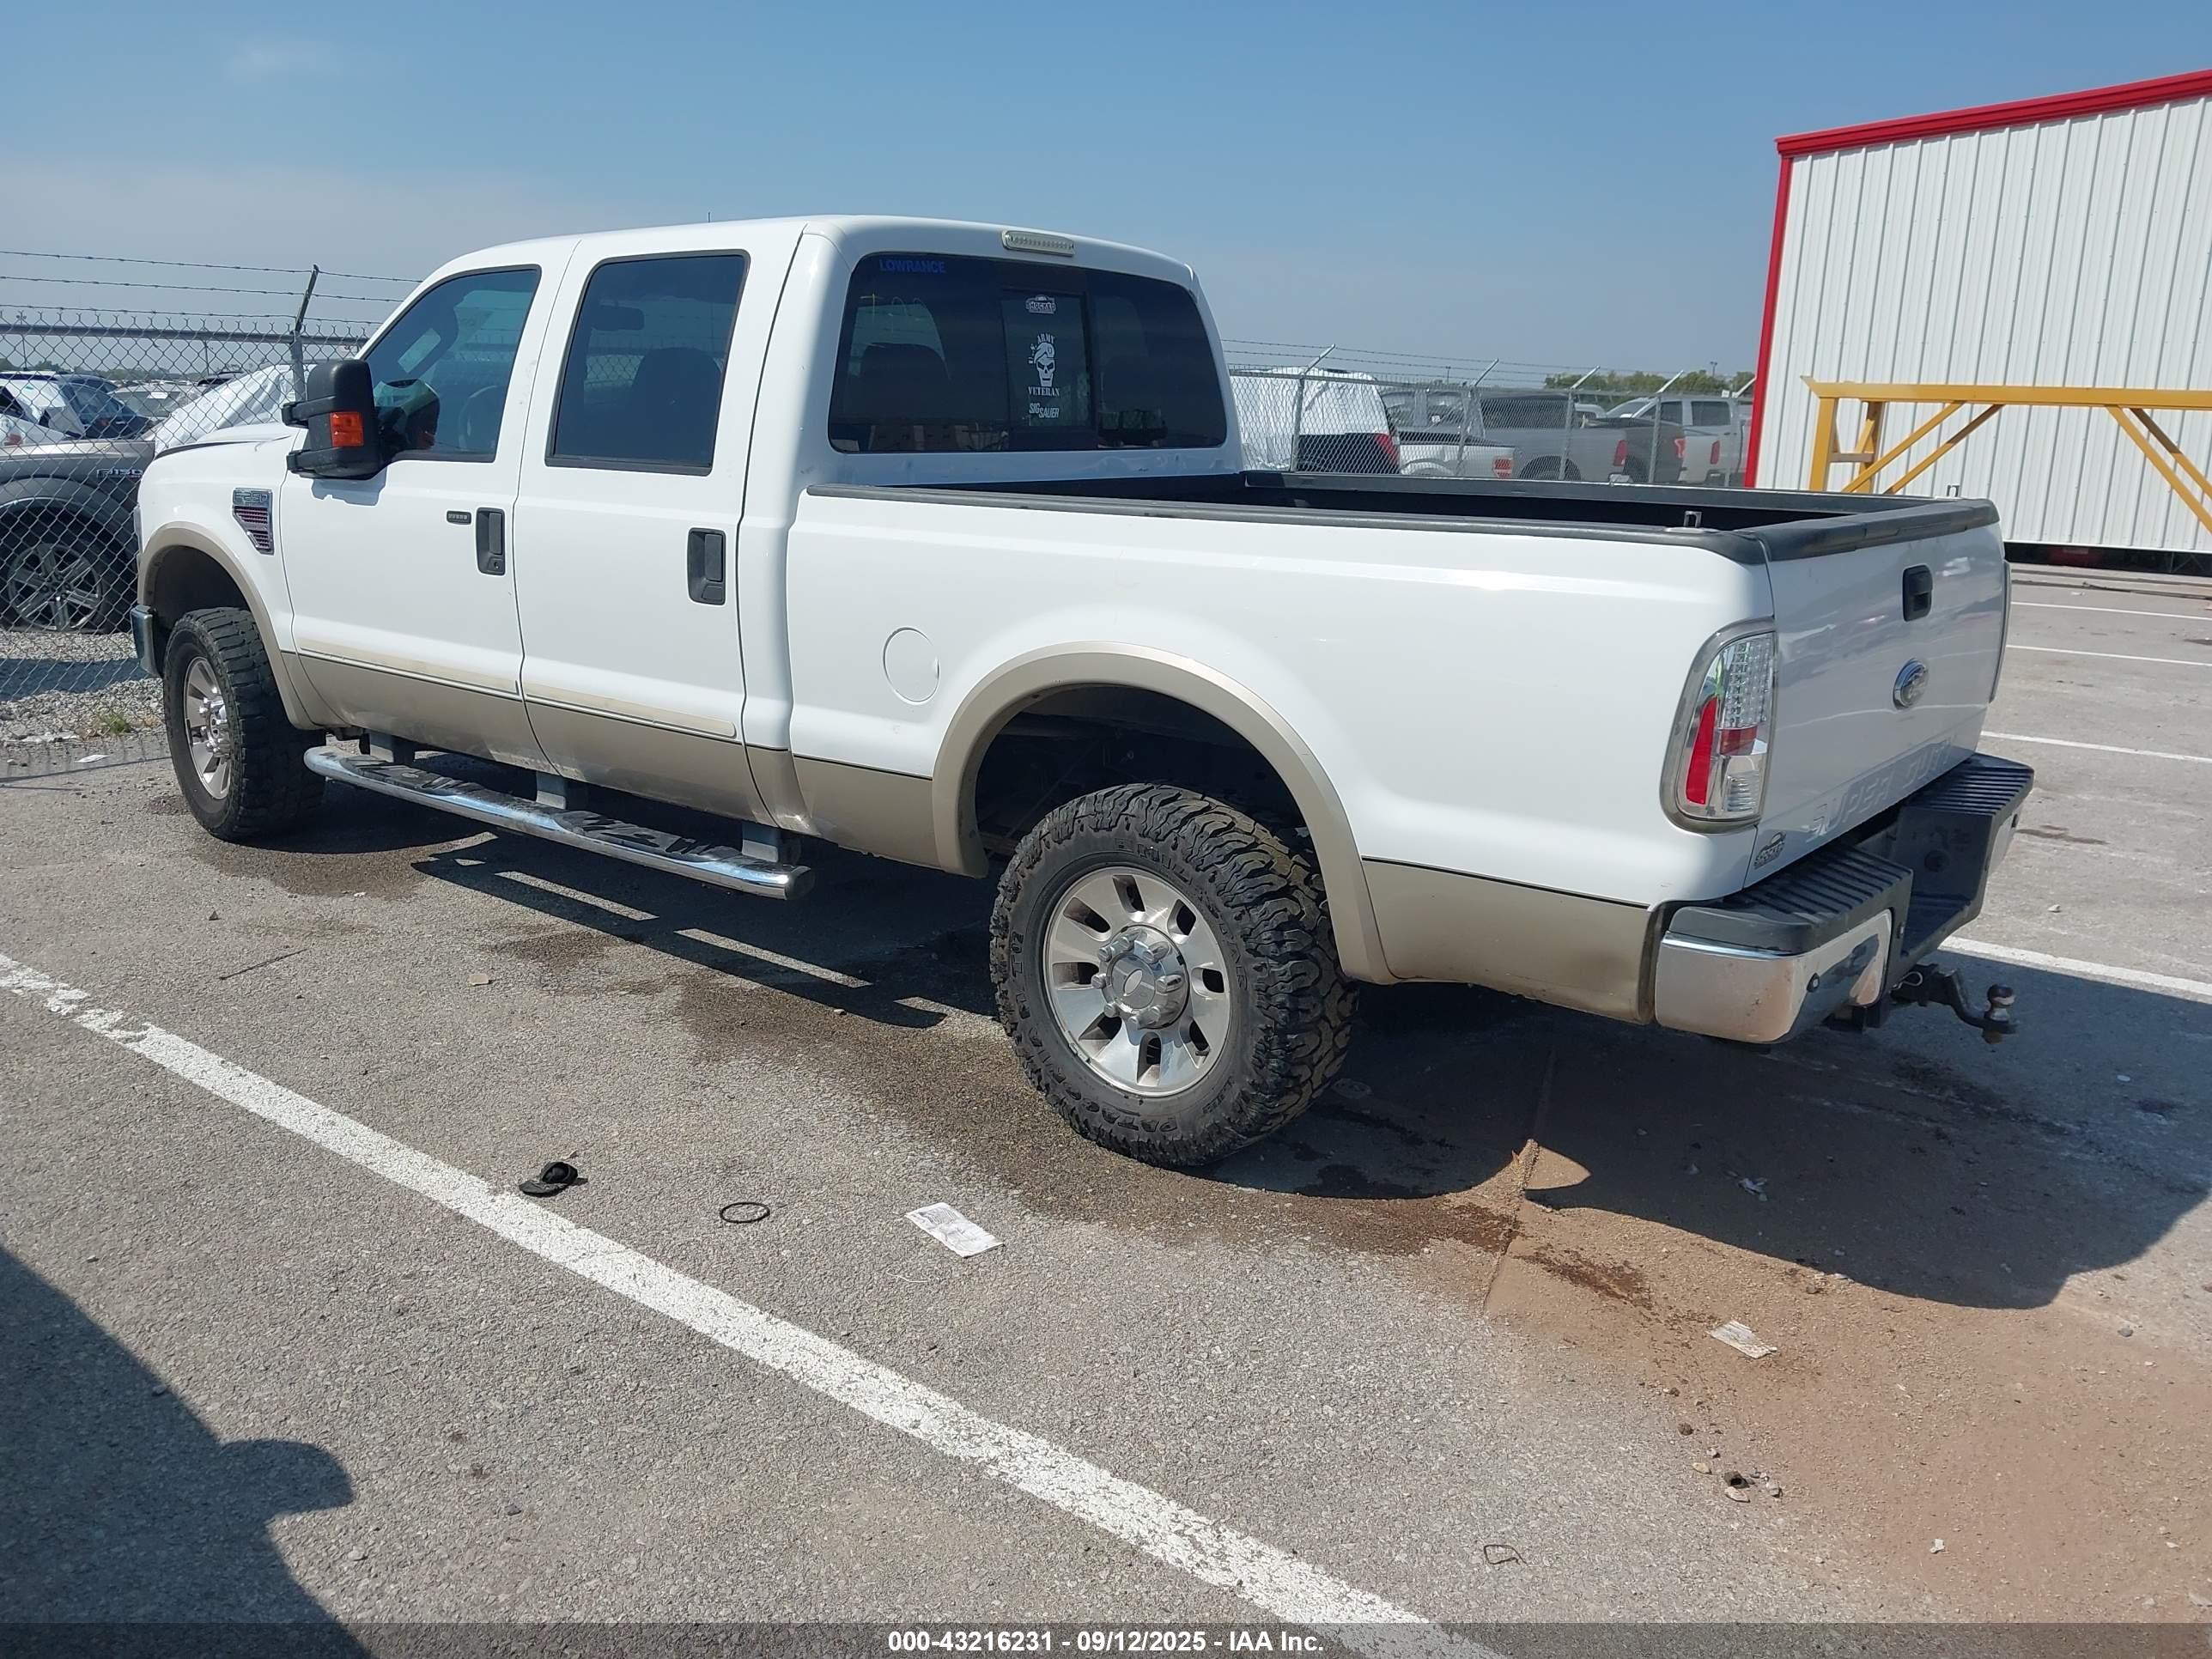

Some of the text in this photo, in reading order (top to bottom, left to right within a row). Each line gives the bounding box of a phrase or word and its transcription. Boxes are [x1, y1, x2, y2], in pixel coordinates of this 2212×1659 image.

[878, 259, 945, 273] LOWRANCE
[1036, 332, 1055, 344] ARMY
[1028, 386, 1060, 397] VETERAN
[1029, 403, 1060, 418] SIG SAUER
